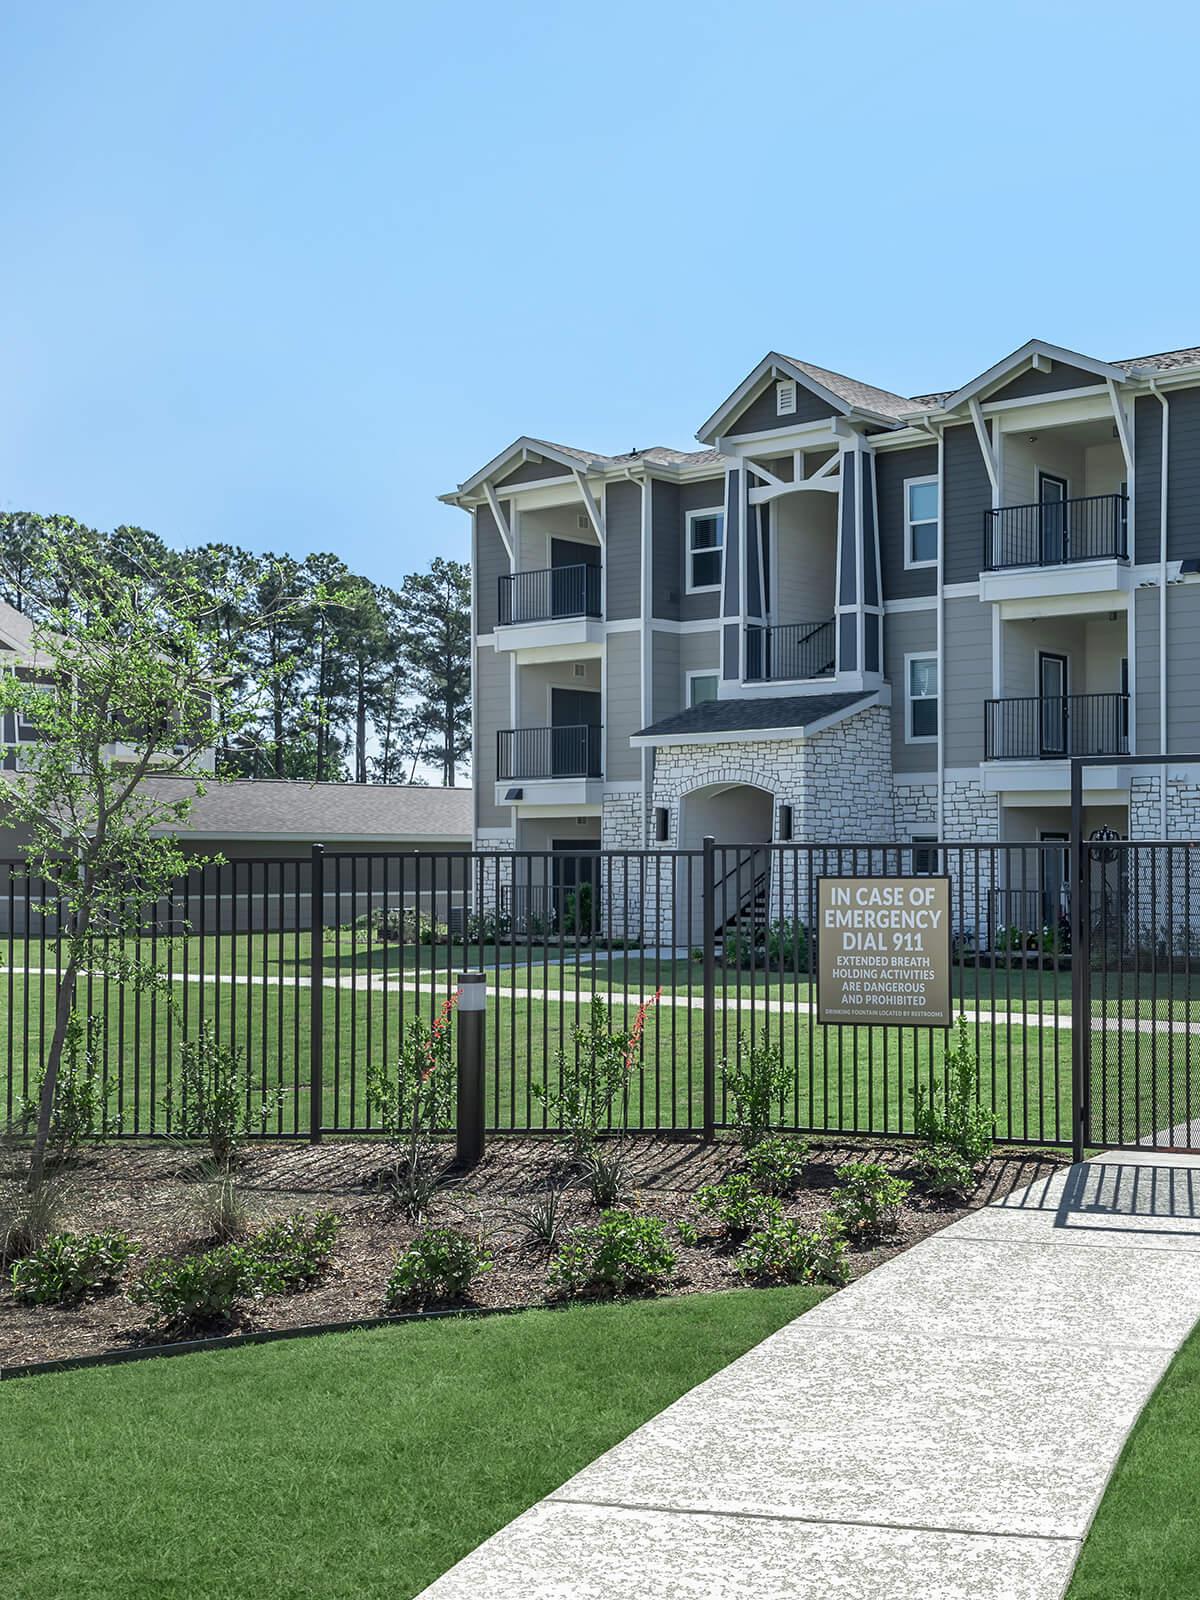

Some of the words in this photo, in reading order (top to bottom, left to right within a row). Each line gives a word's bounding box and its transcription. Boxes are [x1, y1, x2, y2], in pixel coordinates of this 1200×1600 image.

[831, 887, 850, 906] IN
[856, 887, 904, 906] CASE
[909, 887, 936, 906] OF
[825, 910, 942, 928] EMERGENCY
[843, 932, 887, 951] DIAL
[892, 932, 924, 952] 911
[836, 956, 889, 967] EXTENDED
[891, 956, 930, 967] BREATH
[832, 969, 877, 979] HOLDING
[880, 969, 935, 980] ACTIVITIES
[842, 982, 861, 992] ARE
[863, 982, 925, 993] DANGEROUS
[841, 994, 863, 1005] AND
[865, 995, 926, 1006] PROHIBITED
[879, 1009, 902, 1017] LOCATED
